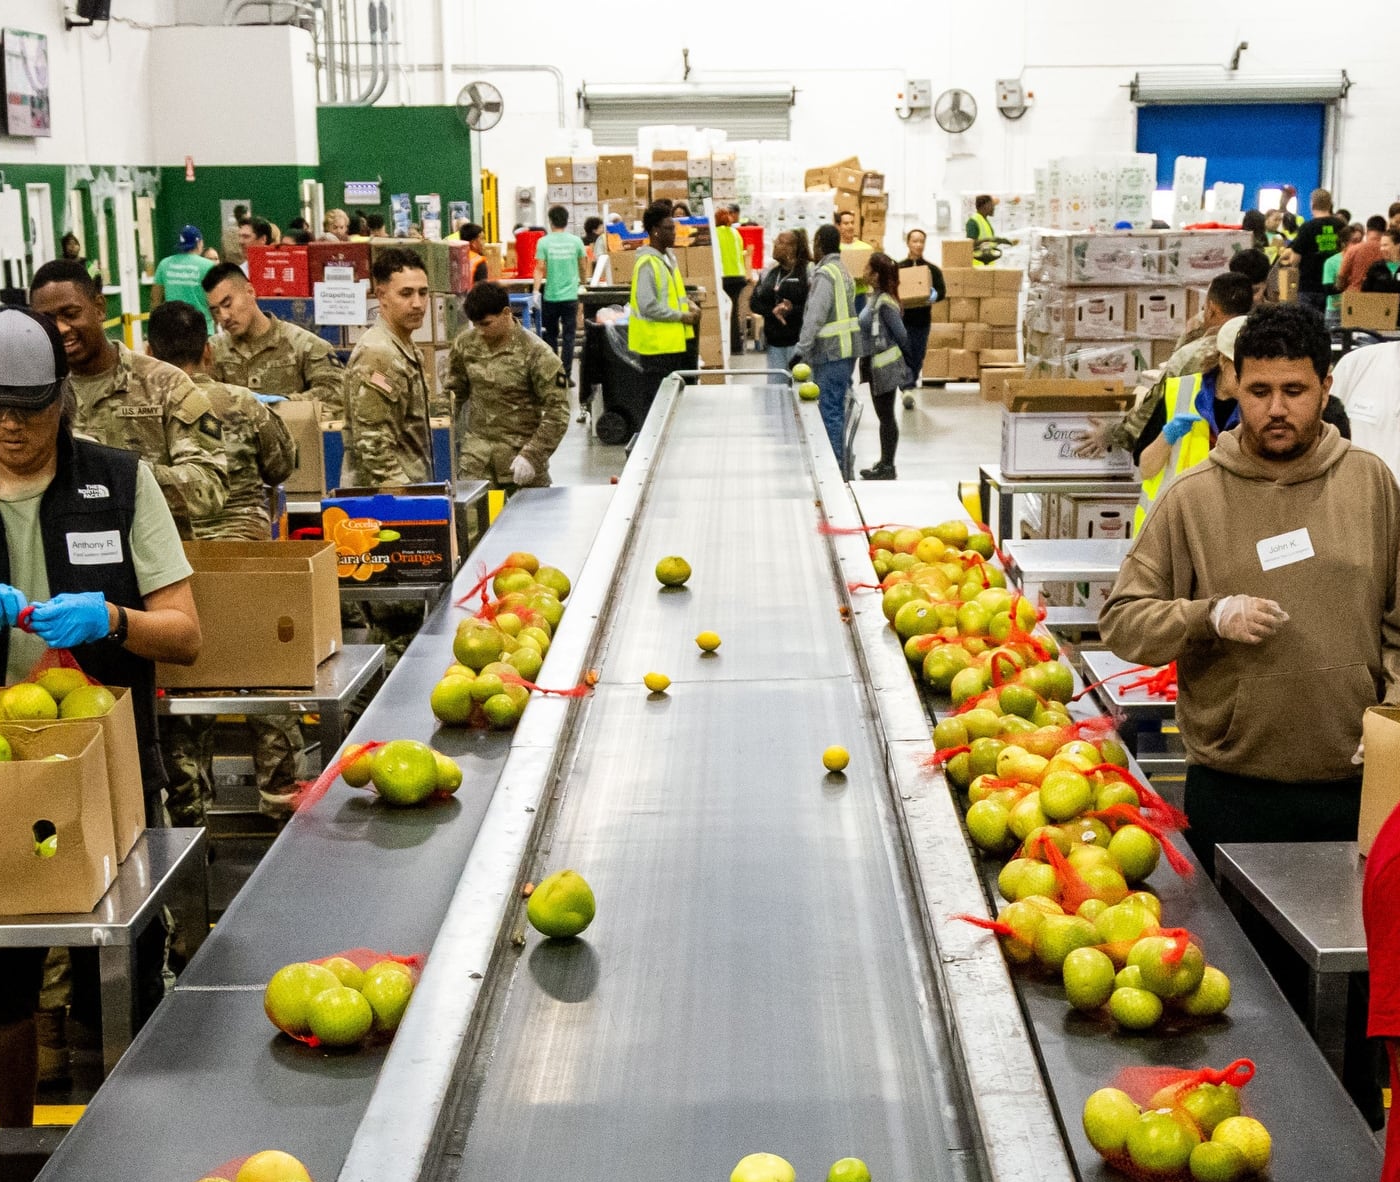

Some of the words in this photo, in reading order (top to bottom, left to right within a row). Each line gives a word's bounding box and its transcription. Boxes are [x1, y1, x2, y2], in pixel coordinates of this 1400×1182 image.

[121, 407, 136, 416] U.S.
[137, 406, 159, 415] ARMY
[348, 519, 379, 529] Cecelia
[72, 541, 104, 549] Anthony
[1269, 543, 1289, 554] John
[361, 552, 390, 564] Cara
[390, 551, 443, 565] Oranges
